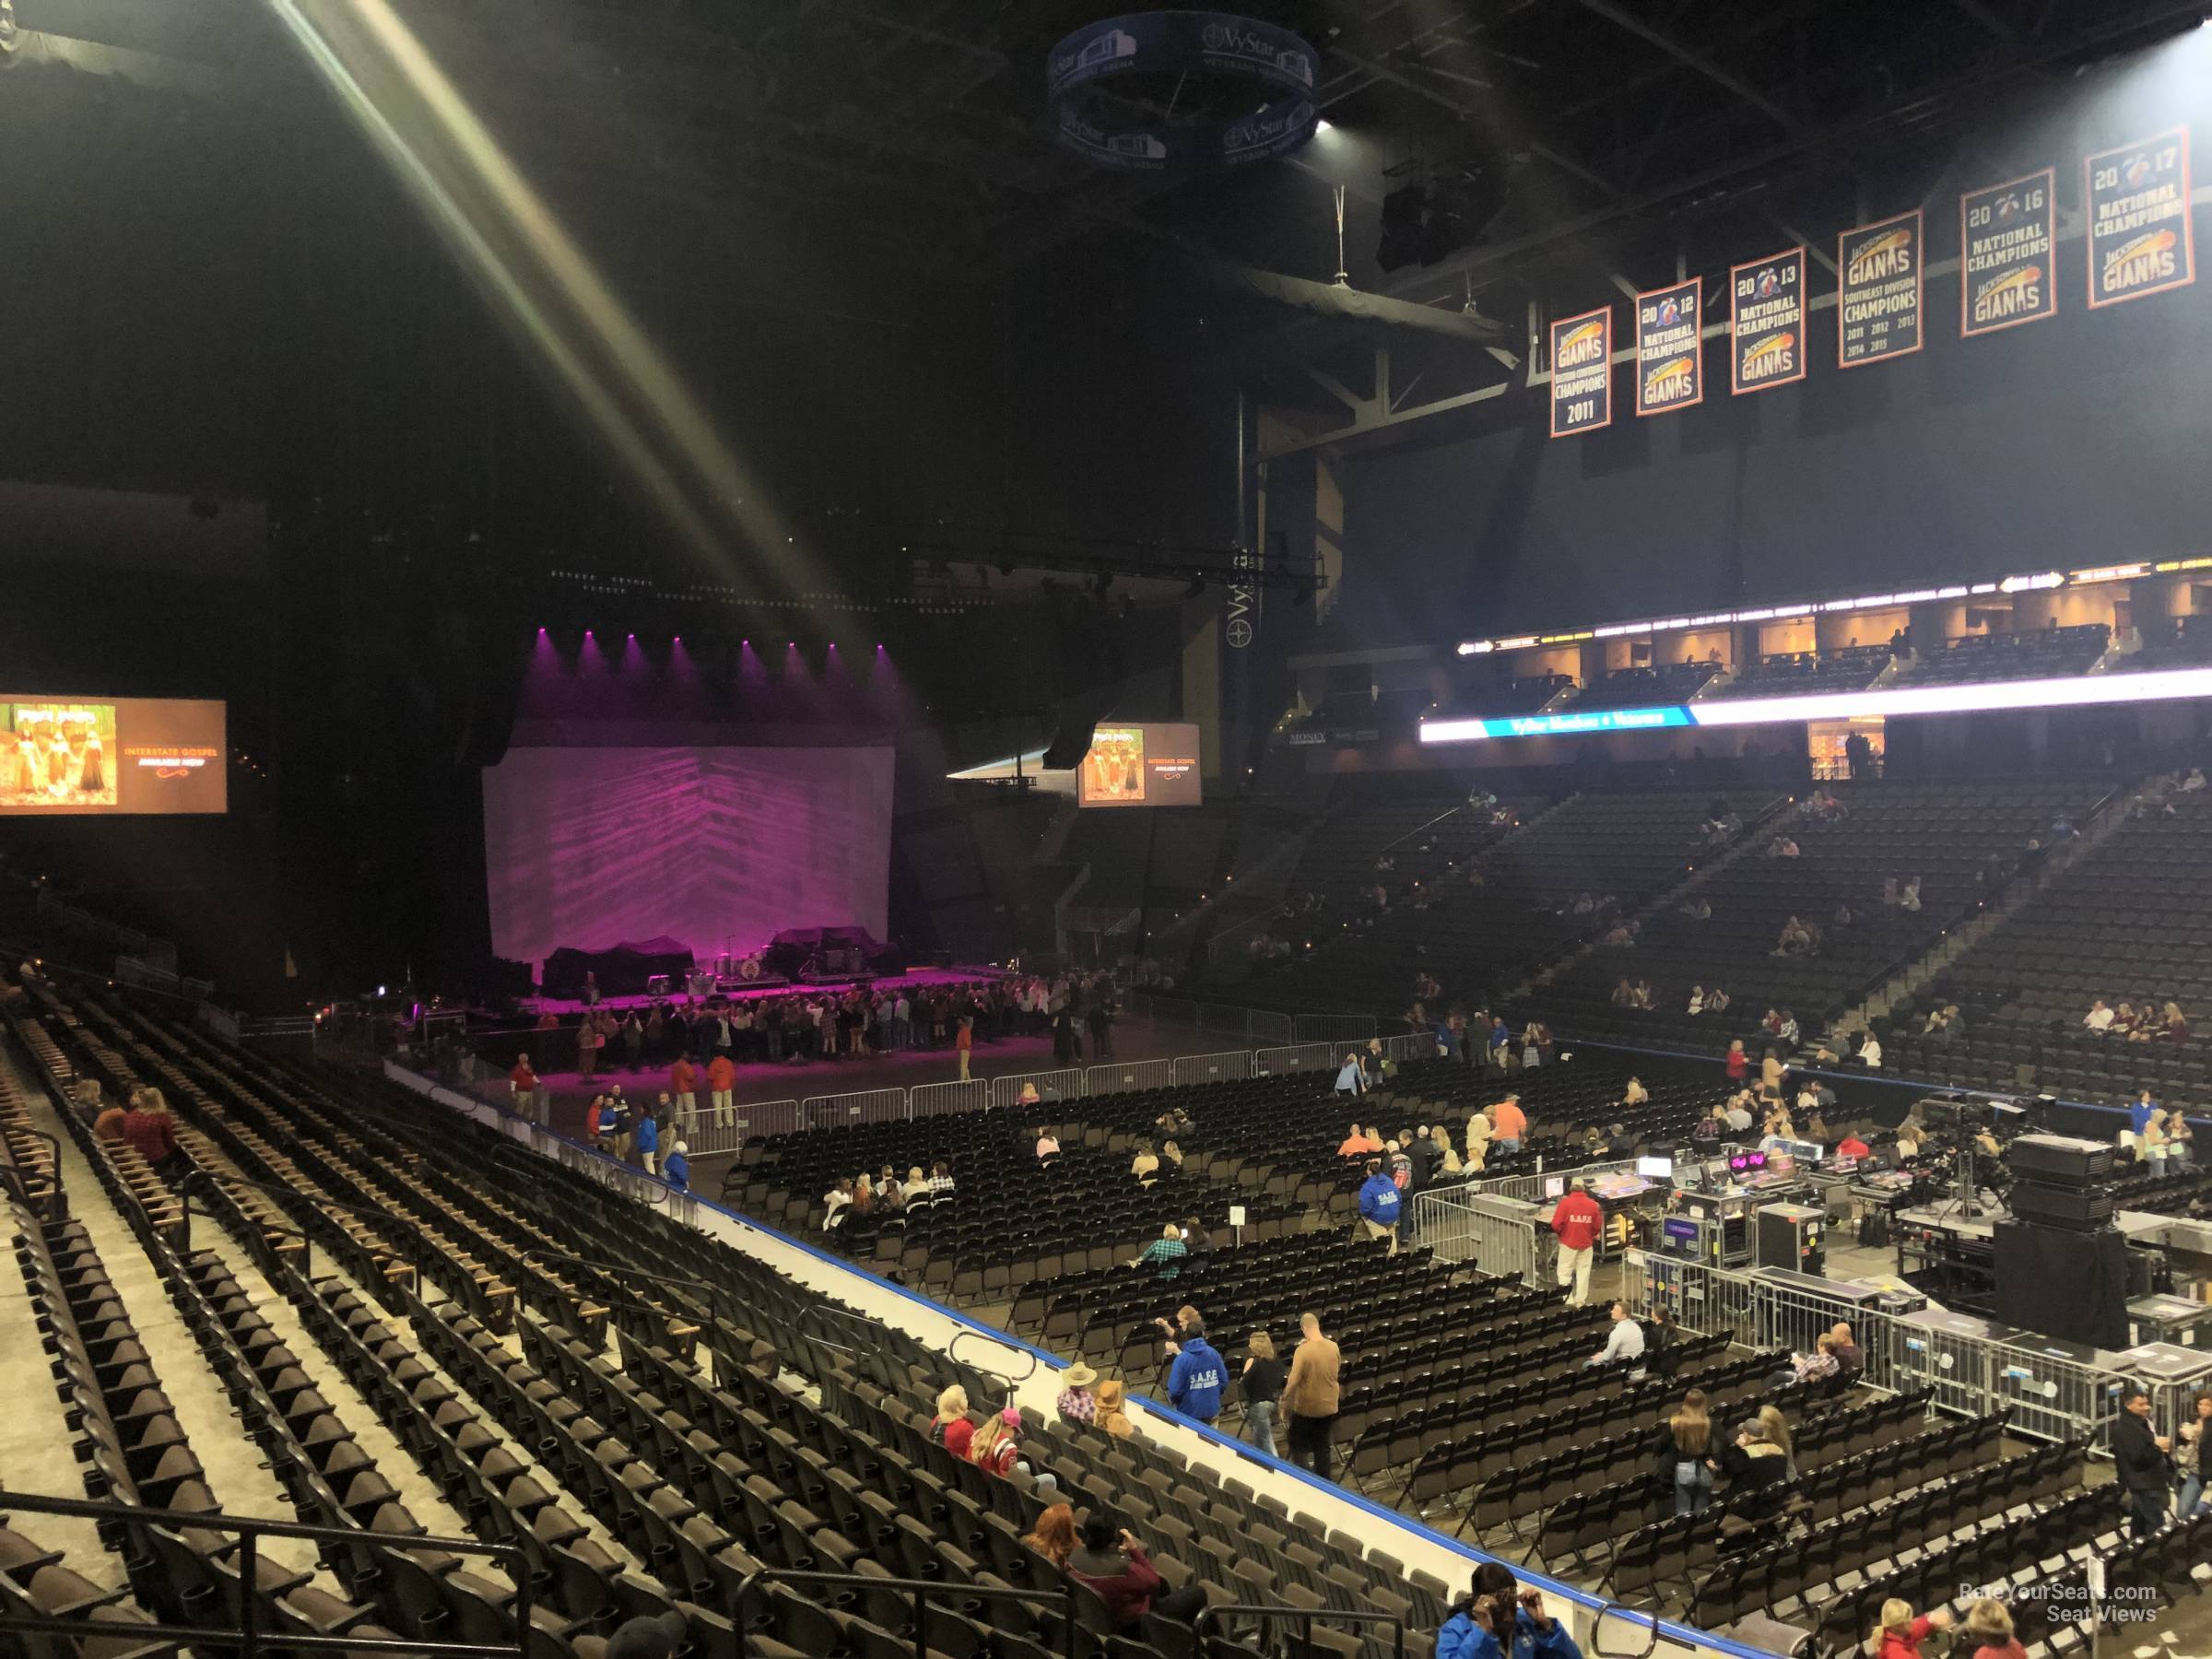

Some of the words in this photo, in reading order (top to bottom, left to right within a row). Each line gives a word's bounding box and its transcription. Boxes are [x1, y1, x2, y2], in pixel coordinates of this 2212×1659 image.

[1225, 27, 1273, 55] VyStar
[2095, 167, 2118, 191] 20
[2156, 147, 2175, 171] 17
[1970, 206, 1991, 228] 20
[2025, 189, 2043, 212] 16
[2095, 198, 2183, 238] CHAMPIONS
[2100, 184, 2176, 219] NATIONAL
[1969, 237, 2049, 272] CHAMPIONS
[1973, 222, 2042, 255] NATIONAL
[1738, 277, 1755, 297] 20
[1781, 265, 1796, 285] 13
[1849, 245, 1910, 285] GIANTS
[2104, 249, 2175, 292] GIANTS
[1845, 285, 1883, 305] SOUTHEAST
[1885, 276, 1916, 295] DIVISION
[1845, 290, 1916, 323] CHAMPIONS
[1975, 283, 2040, 323] GIANTS
[1641, 306, 1657, 324] 20
[1680, 296, 1694, 314] 12
[1736, 309, 1799, 336] CHAMPIONS
[1740, 295, 1795, 321] NATIONAL
[1871, 322, 1888, 335] 2012
[1898, 314, 1915, 328] 2013
[1559, 335, 1603, 368] GIANTS
[1641, 335, 1697, 361] CHAMPIONS
[1644, 324, 1694, 347] NATIONAL
[1742, 348, 1793, 381] GIANTS
[1556, 373, 1606, 399] CHAMPIONS
[1644, 372, 1692, 405] GIANTS
[1568, 400, 1594, 424] 2011
[124, 747, 178, 757] INTERSTATE
[181, 747, 218, 757] GOSPEL
